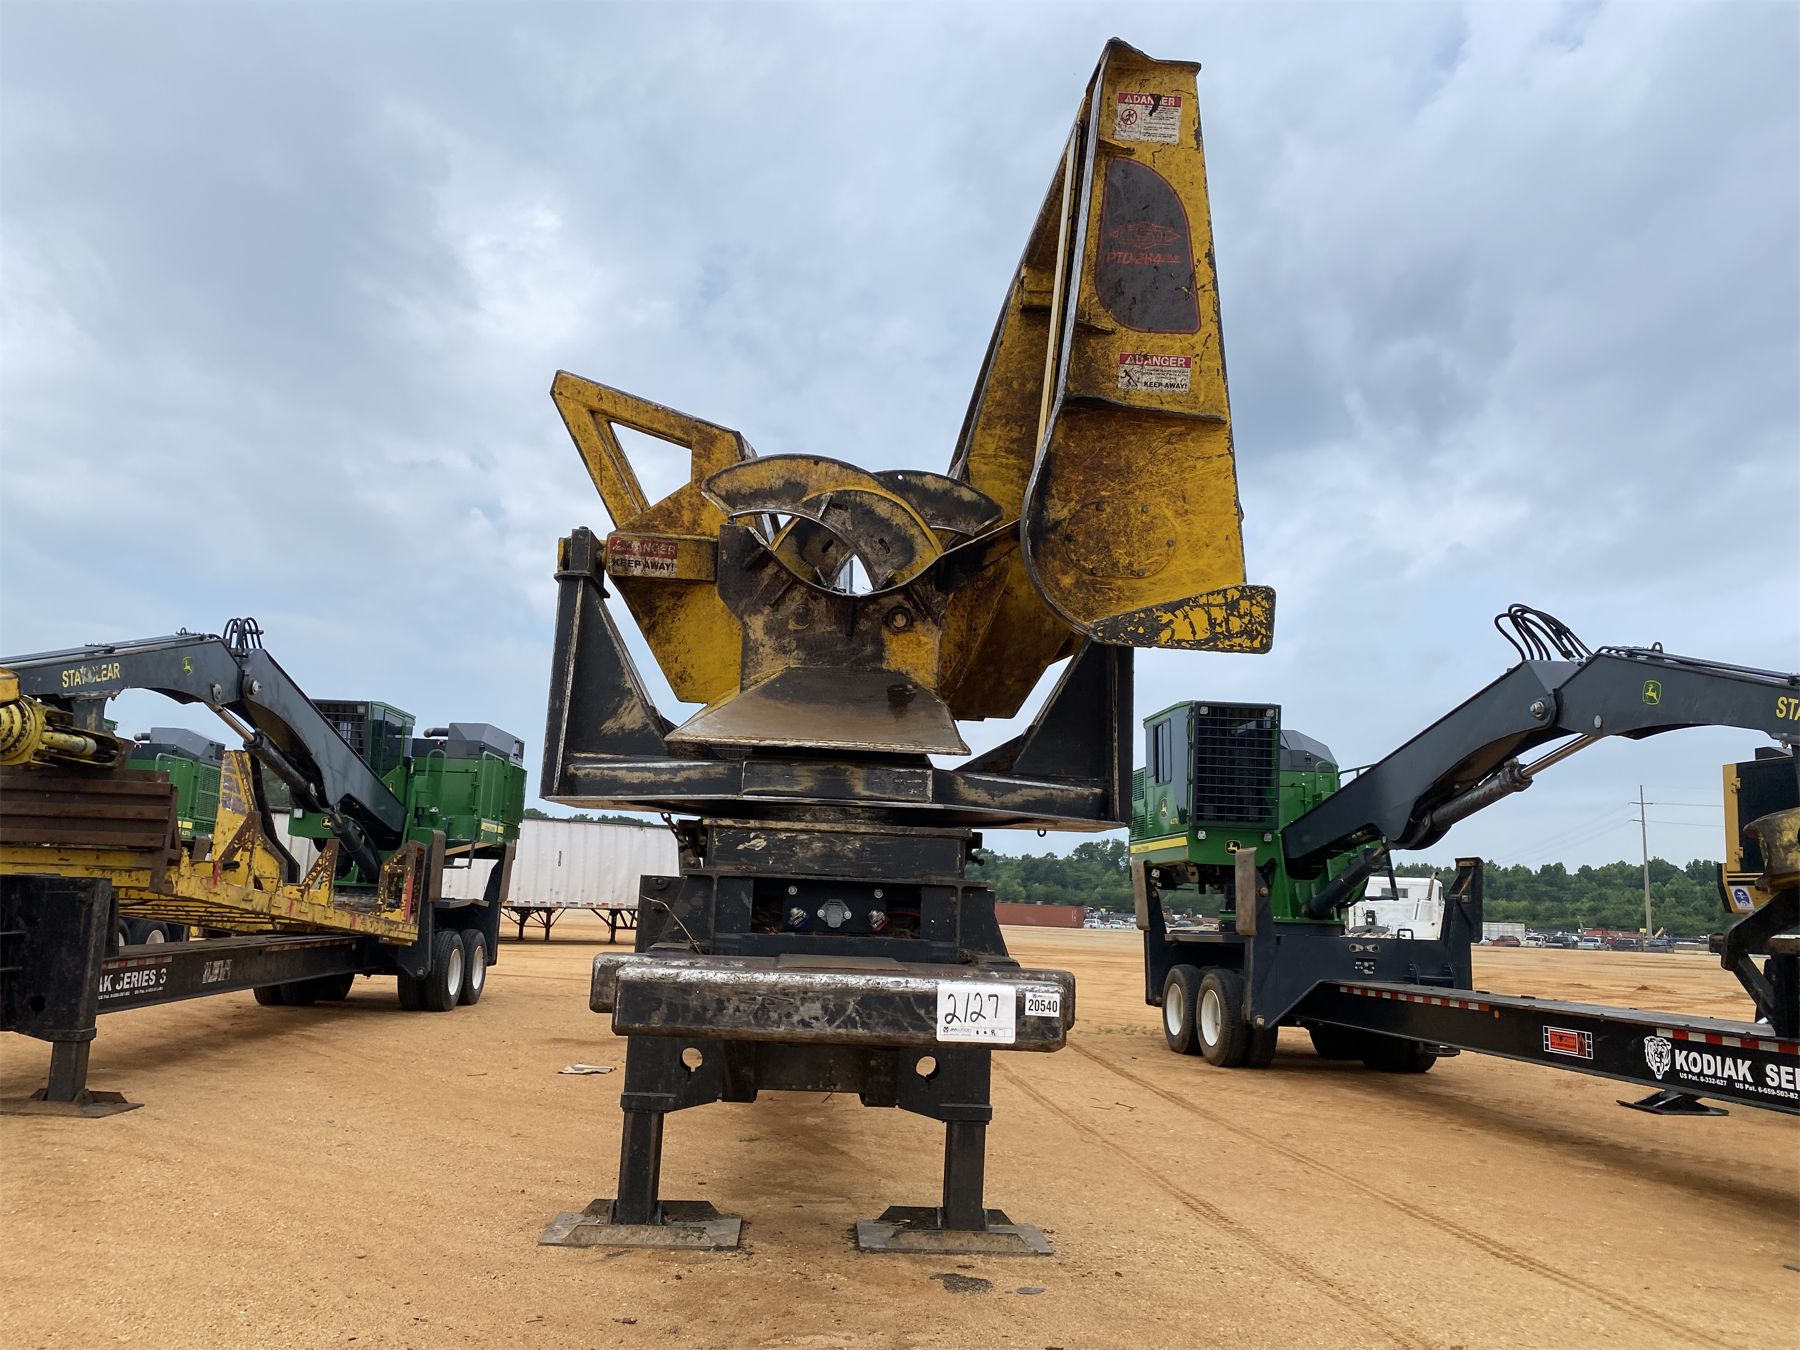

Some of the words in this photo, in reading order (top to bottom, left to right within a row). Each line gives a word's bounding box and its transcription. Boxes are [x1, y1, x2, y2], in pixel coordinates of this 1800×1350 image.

[1133, 95, 1175, 106] DANER
[612, 558, 641, 568] KEEP
[644, 560, 674, 572] AWAY!
[944, 992, 999, 1025] 2127
[1028, 999, 1058, 1013] 20540
[1675, 1049, 1753, 1082] KODIAK
[1734, 1081, 1744, 1089] US
